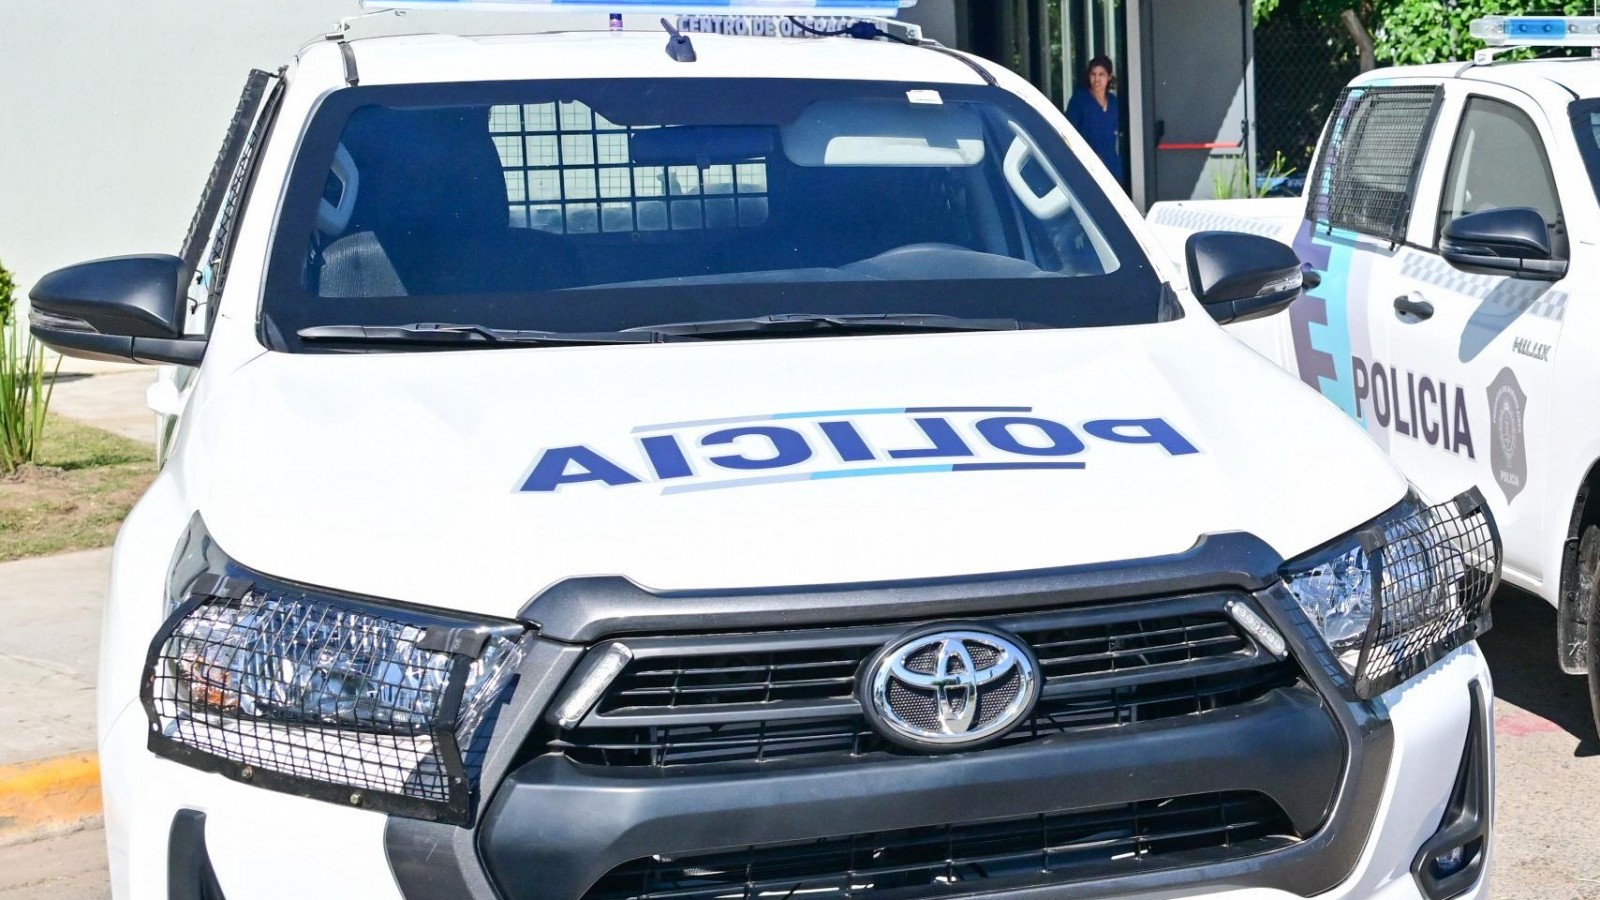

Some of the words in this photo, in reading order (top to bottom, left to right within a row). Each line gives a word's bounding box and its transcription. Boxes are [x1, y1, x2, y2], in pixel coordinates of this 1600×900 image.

[677, 16, 749, 35] CENTRO
[752, 17, 776, 36] DE
[1350, 355, 1476, 460] POLICIA
